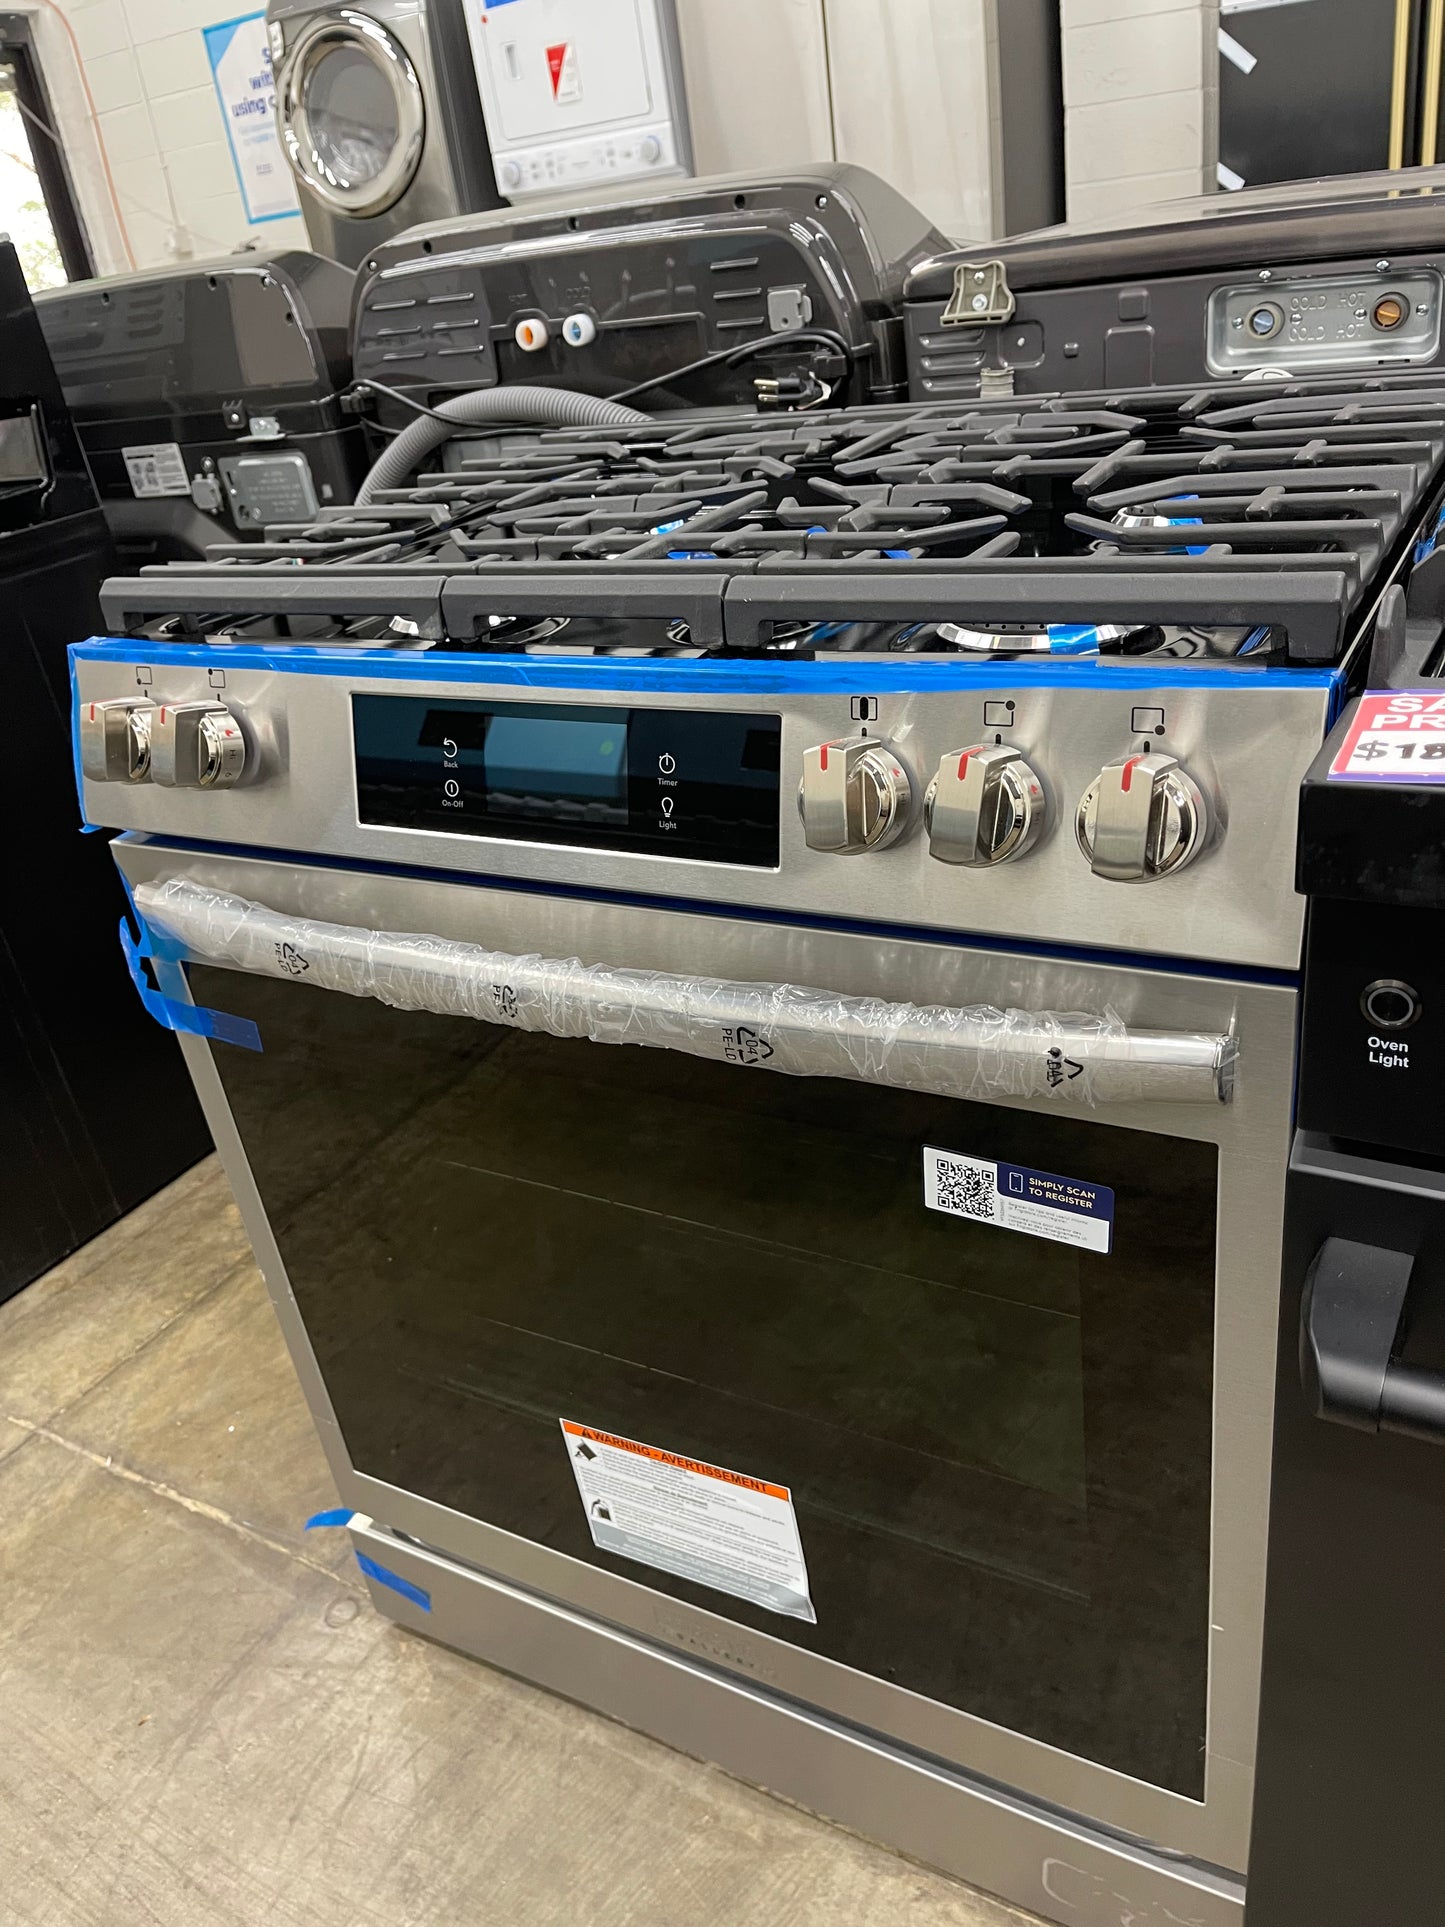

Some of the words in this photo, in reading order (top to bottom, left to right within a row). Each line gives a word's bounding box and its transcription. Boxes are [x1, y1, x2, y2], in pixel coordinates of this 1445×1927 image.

[231, 97, 267, 117] using
[443, 761, 459, 769] Back
[657, 777, 678, 786] Timer
[441, 799, 464, 808] On-Off
[659, 820, 677, 831] Light
[722, 1027, 737, 1061] PE-LD
[745, 1039, 759, 1055] 04
[1367, 1036, 1409, 1053] Oven
[1368, 1051, 1410, 1068] Light
[1028, 1177, 1065, 1192] SIMPLY
[1066, 1186, 1096, 1200] SCAN
[1028, 1187, 1044, 1197] TO
[1045, 1191, 1093, 1209] REGISTER
[592, 1431, 651, 1457] WARNING
[661, 1452, 769, 1493] AVERTISSEMENT
